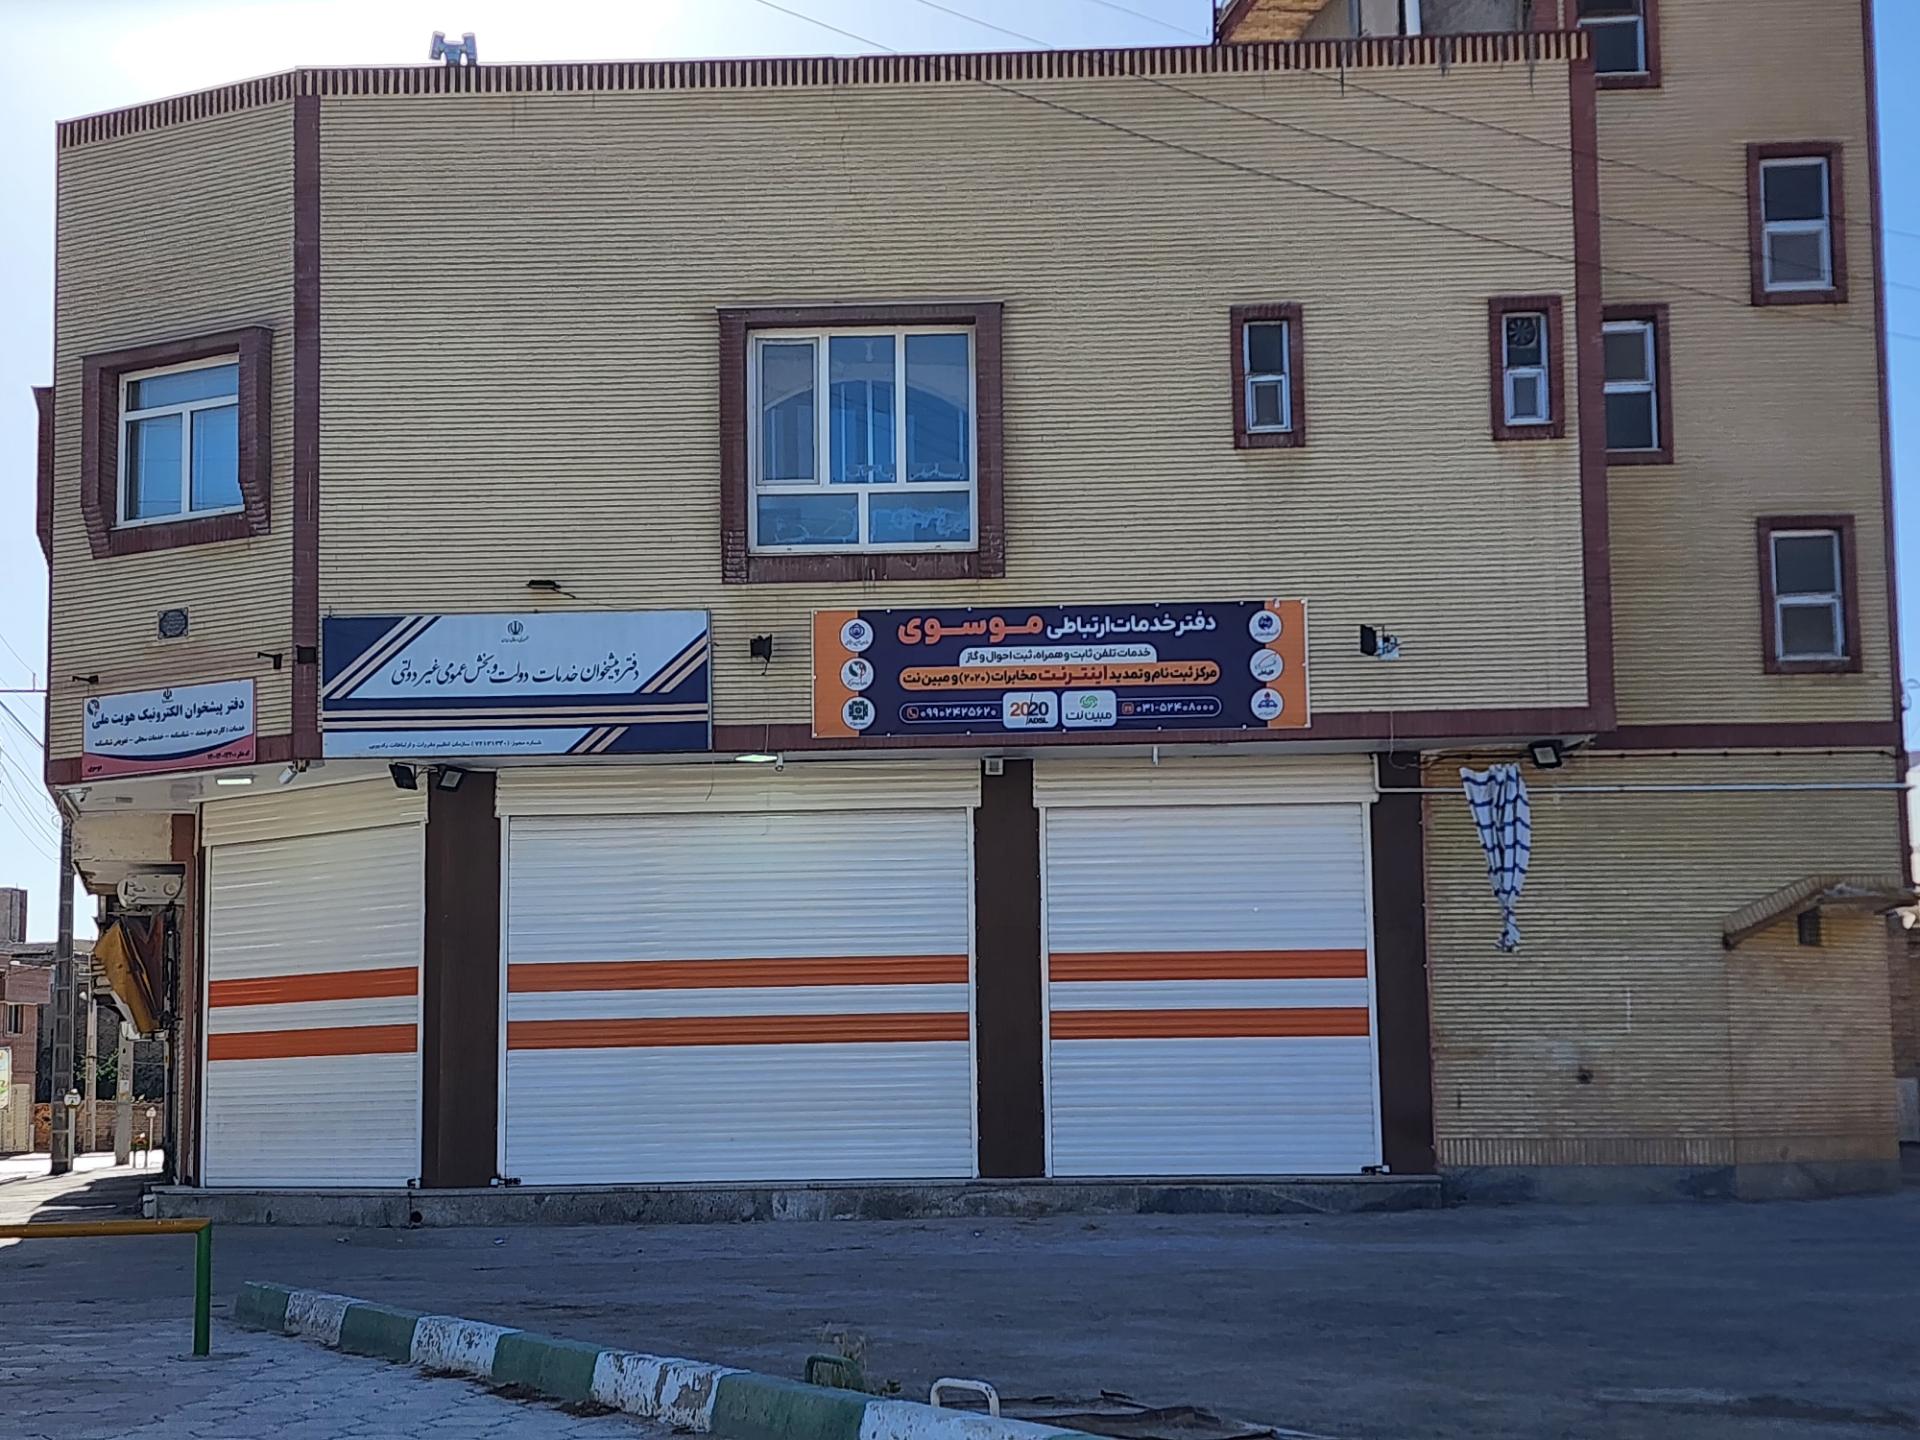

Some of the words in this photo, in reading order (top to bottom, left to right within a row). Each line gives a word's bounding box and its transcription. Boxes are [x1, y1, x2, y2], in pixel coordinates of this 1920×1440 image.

[898, 615, 1044, 645] موسوی
[1046, 615, 1110, 639] ارتباطی
[1111, 613, 1177, 633] خدمات
[1175, 610, 1217, 636] دفتر
[965, 650, 980, 664] گاز
[986, 650, 1012, 663] احوال
[1013, 649, 1033, 662] ثبت
[1070, 648, 1092, 661] ثابت
[1093, 647, 1116, 661] تلفن
[1117, 647, 1151, 657] خدمات
[391, 659, 418, 685] دولتی
[413, 659, 440, 687] غیر
[436, 662, 467, 685] عمومی
[464, 653, 495, 683] بخش
[489, 660, 529, 683] دولت
[532, 664, 578, 682] خدمات
[580, 652, 620, 682] پیشخوان
[615, 652, 639, 683] دفتر
[1038, 665, 1108, 685] اینترنت
[1109, 667, 1144, 682] تمدید
[1151, 666, 1169, 682] نام
[1170, 665, 1193, 682] ثبت
[1194, 666, 1217, 681] مرکز
[903, 673, 921, 684] نت
[921, 674, 949, 686] مبین
[991, 671, 1037, 685] مخابرات
[138, 704, 183, 723] الکترونیک
[184, 701, 223, 719] پیشخوان
[225, 697, 245, 715] دفتر
[92, 713, 109, 729] ملی
[111, 712, 136, 726] هویت
[1065, 710, 1084, 721] نت
[1085, 711, 1112, 722] مبین
